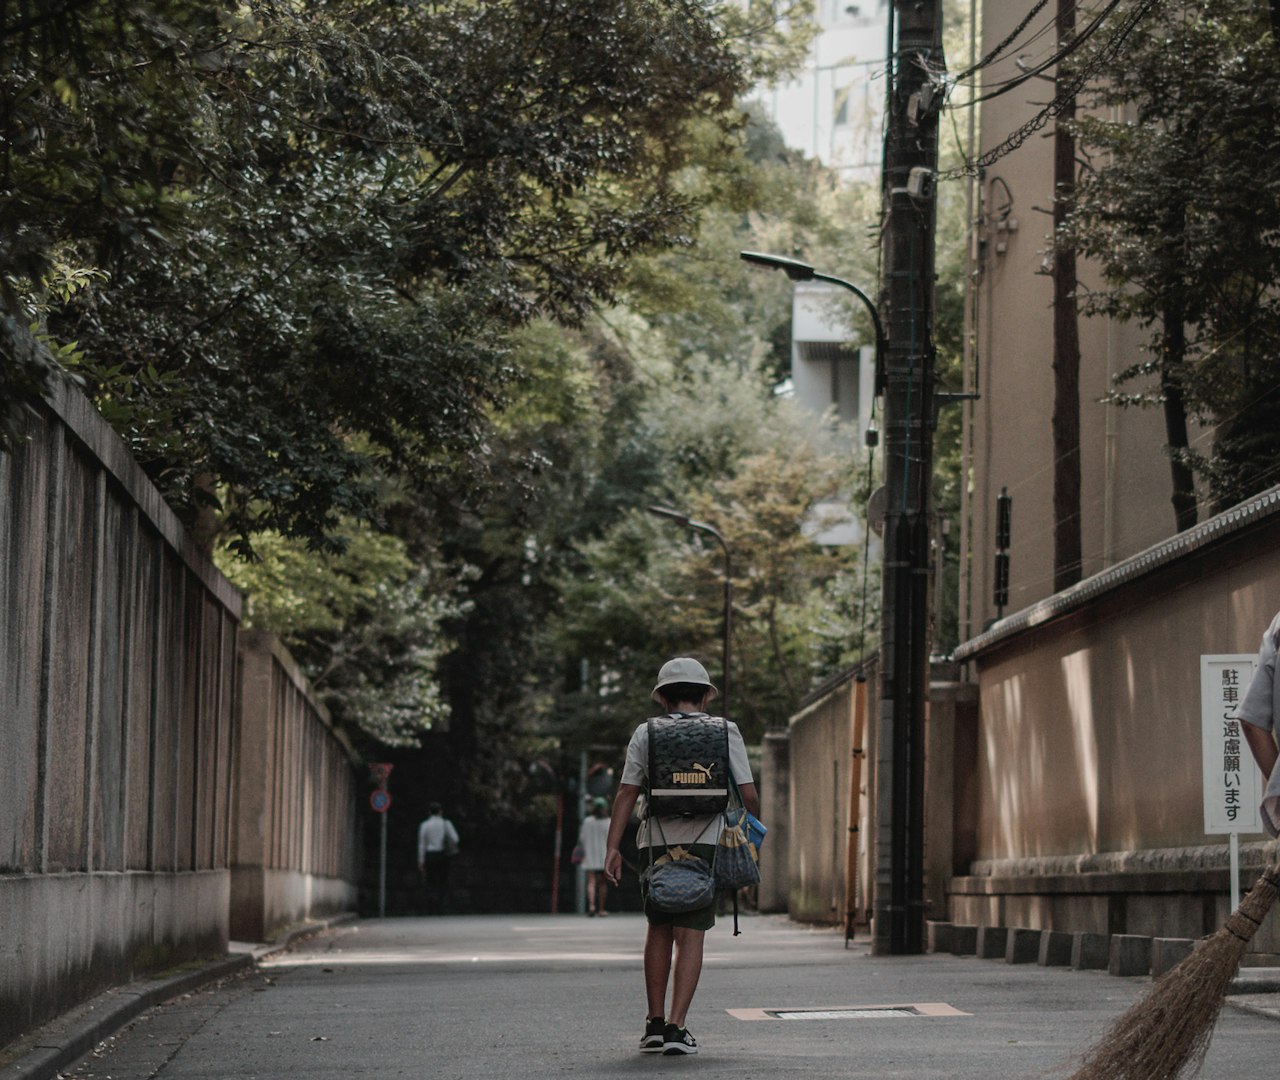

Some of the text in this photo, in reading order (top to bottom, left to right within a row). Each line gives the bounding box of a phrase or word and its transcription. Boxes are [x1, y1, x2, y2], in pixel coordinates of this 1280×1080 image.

[672, 772, 706, 784] PUMA
[1221, 668, 1241, 822] 駐車ご遠慮願います
